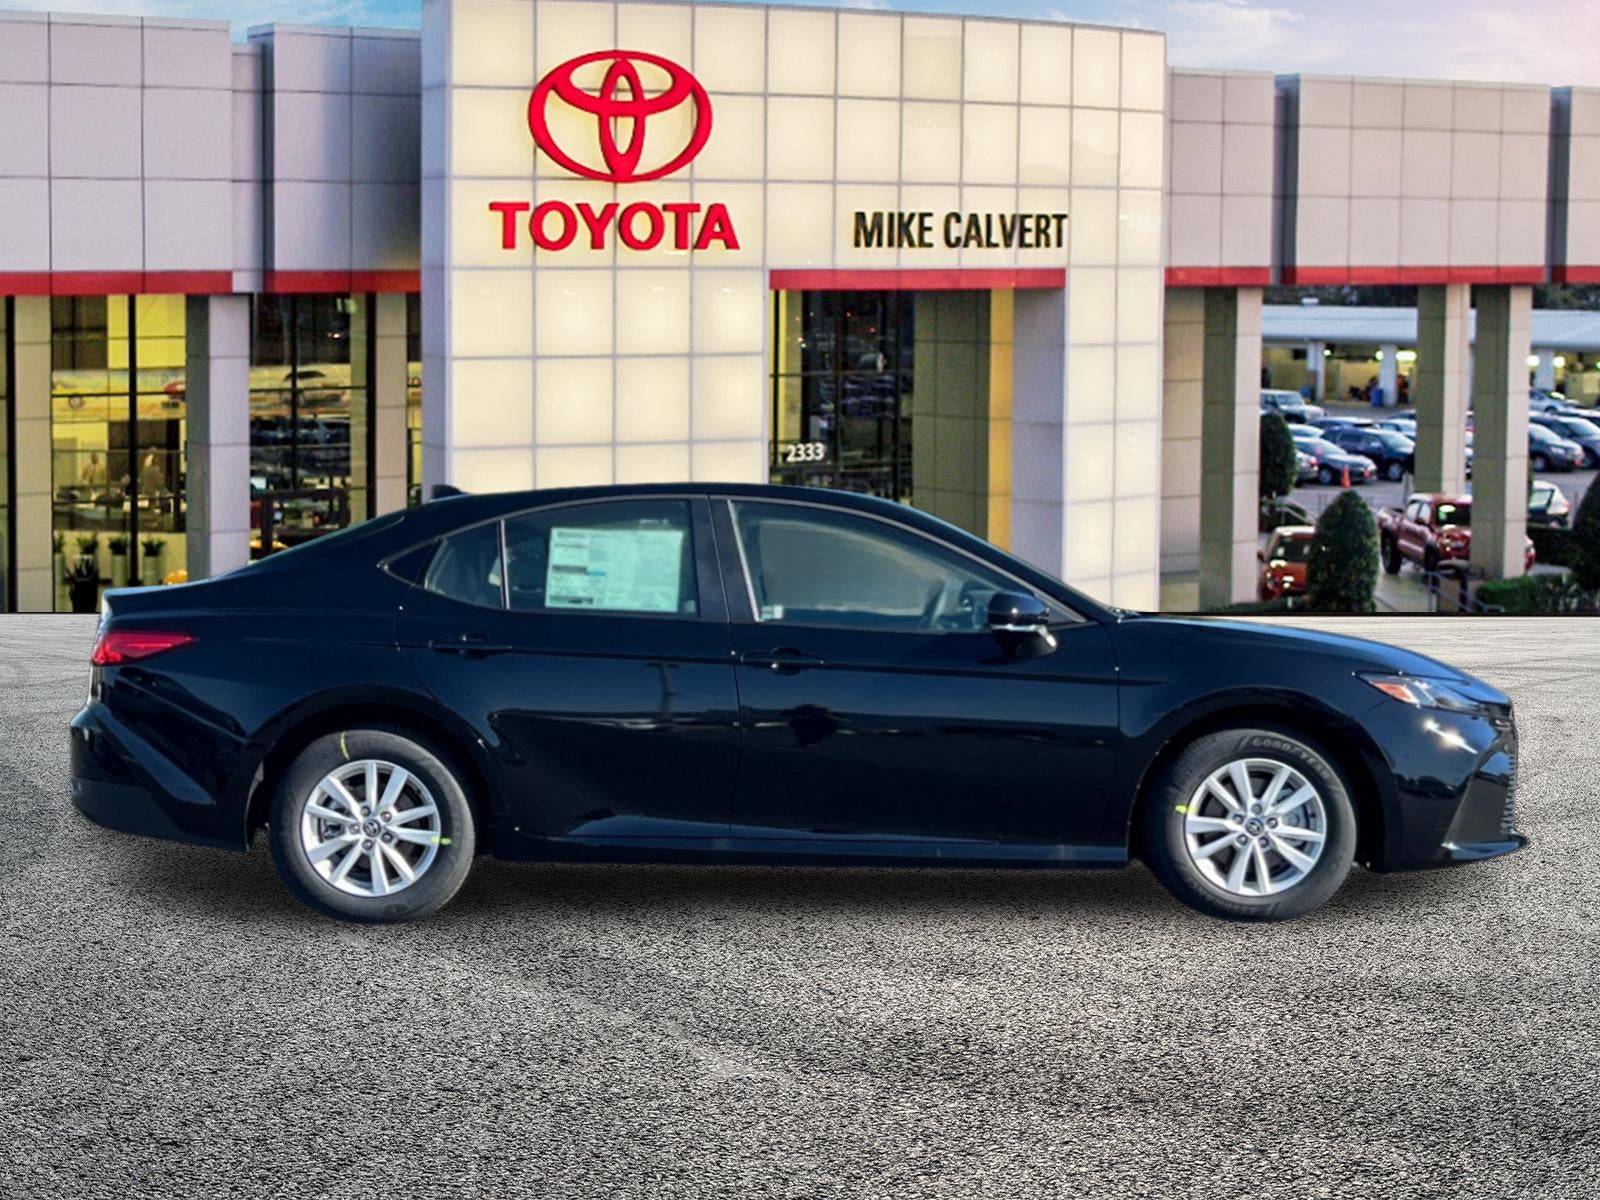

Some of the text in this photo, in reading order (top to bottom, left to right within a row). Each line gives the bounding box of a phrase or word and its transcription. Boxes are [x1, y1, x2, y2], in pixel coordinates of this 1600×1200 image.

[488, 200, 740, 252] TOYOTA
[853, 211, 1068, 249] MIKE CALVERT
[786, 442, 825, 462] 2333
[1252, 737, 1331, 780] GOODYEAR
